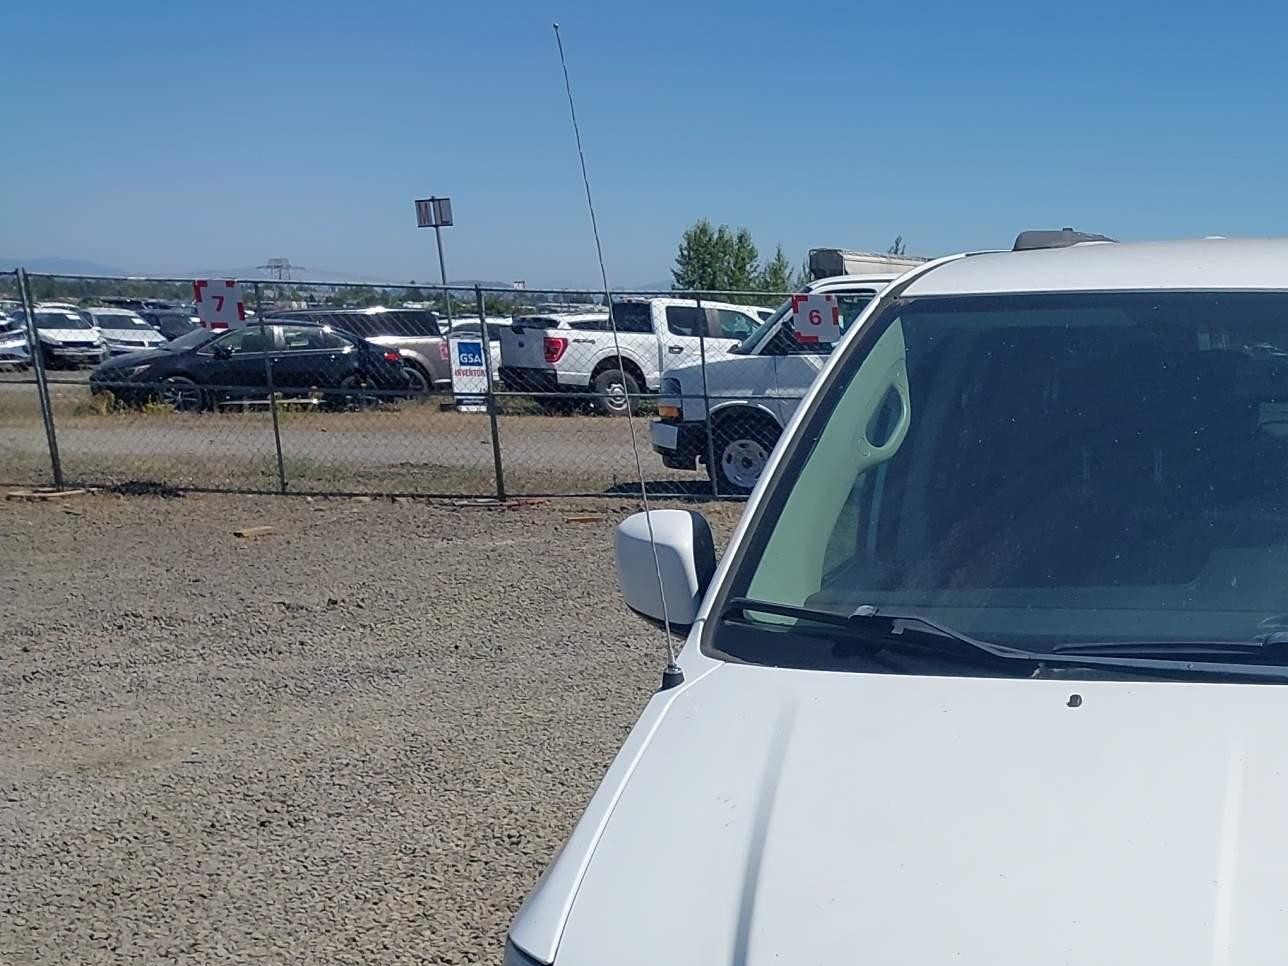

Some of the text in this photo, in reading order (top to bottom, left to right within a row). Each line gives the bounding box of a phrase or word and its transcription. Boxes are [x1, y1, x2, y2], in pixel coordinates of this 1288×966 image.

[418, 202, 430, 224] M
[439, 202, 450, 224] L
[211, 295, 224, 312] 7
[809, 309, 822, 326] 6
[460, 353, 482, 363] GSA
